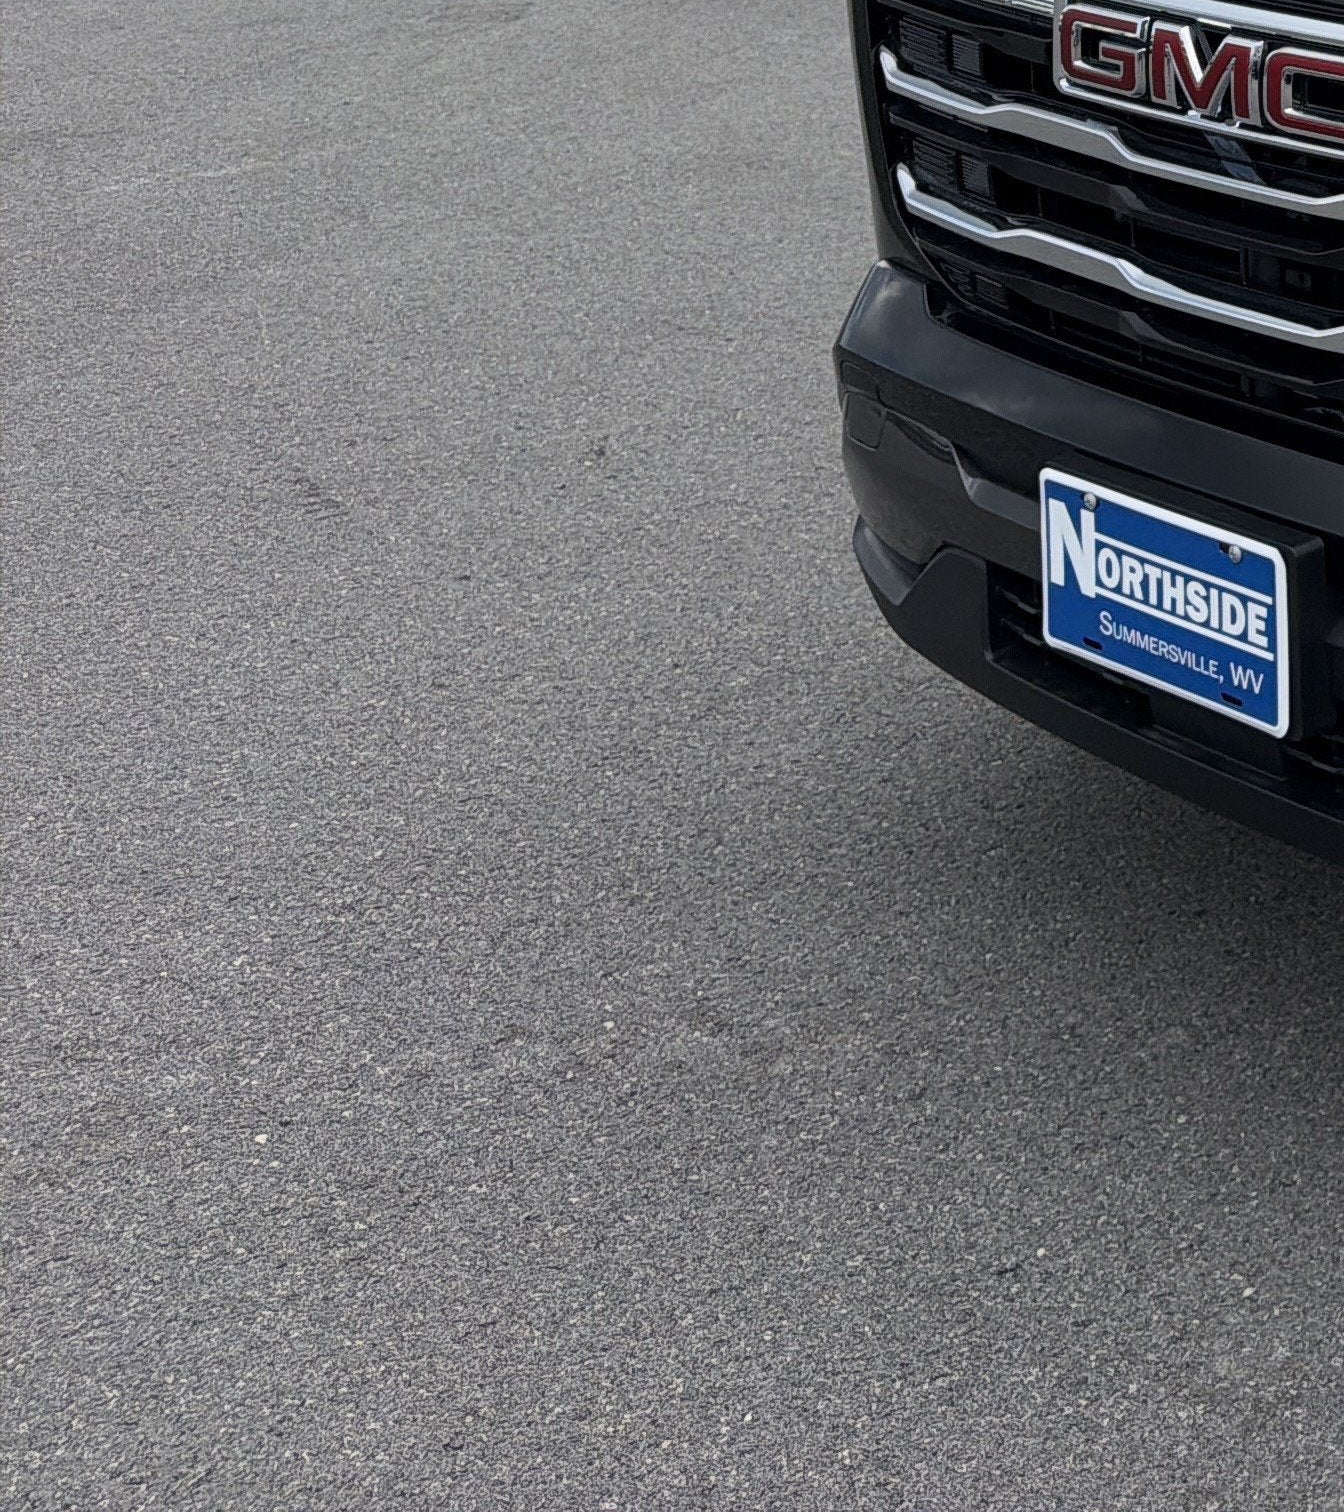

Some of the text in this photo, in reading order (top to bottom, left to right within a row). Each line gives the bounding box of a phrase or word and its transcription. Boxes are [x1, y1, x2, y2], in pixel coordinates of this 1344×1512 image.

[1048, 497, 1269, 648] NORTHSIDE
[1099, 610, 1264, 695] SUMMERSVILLE, WV
